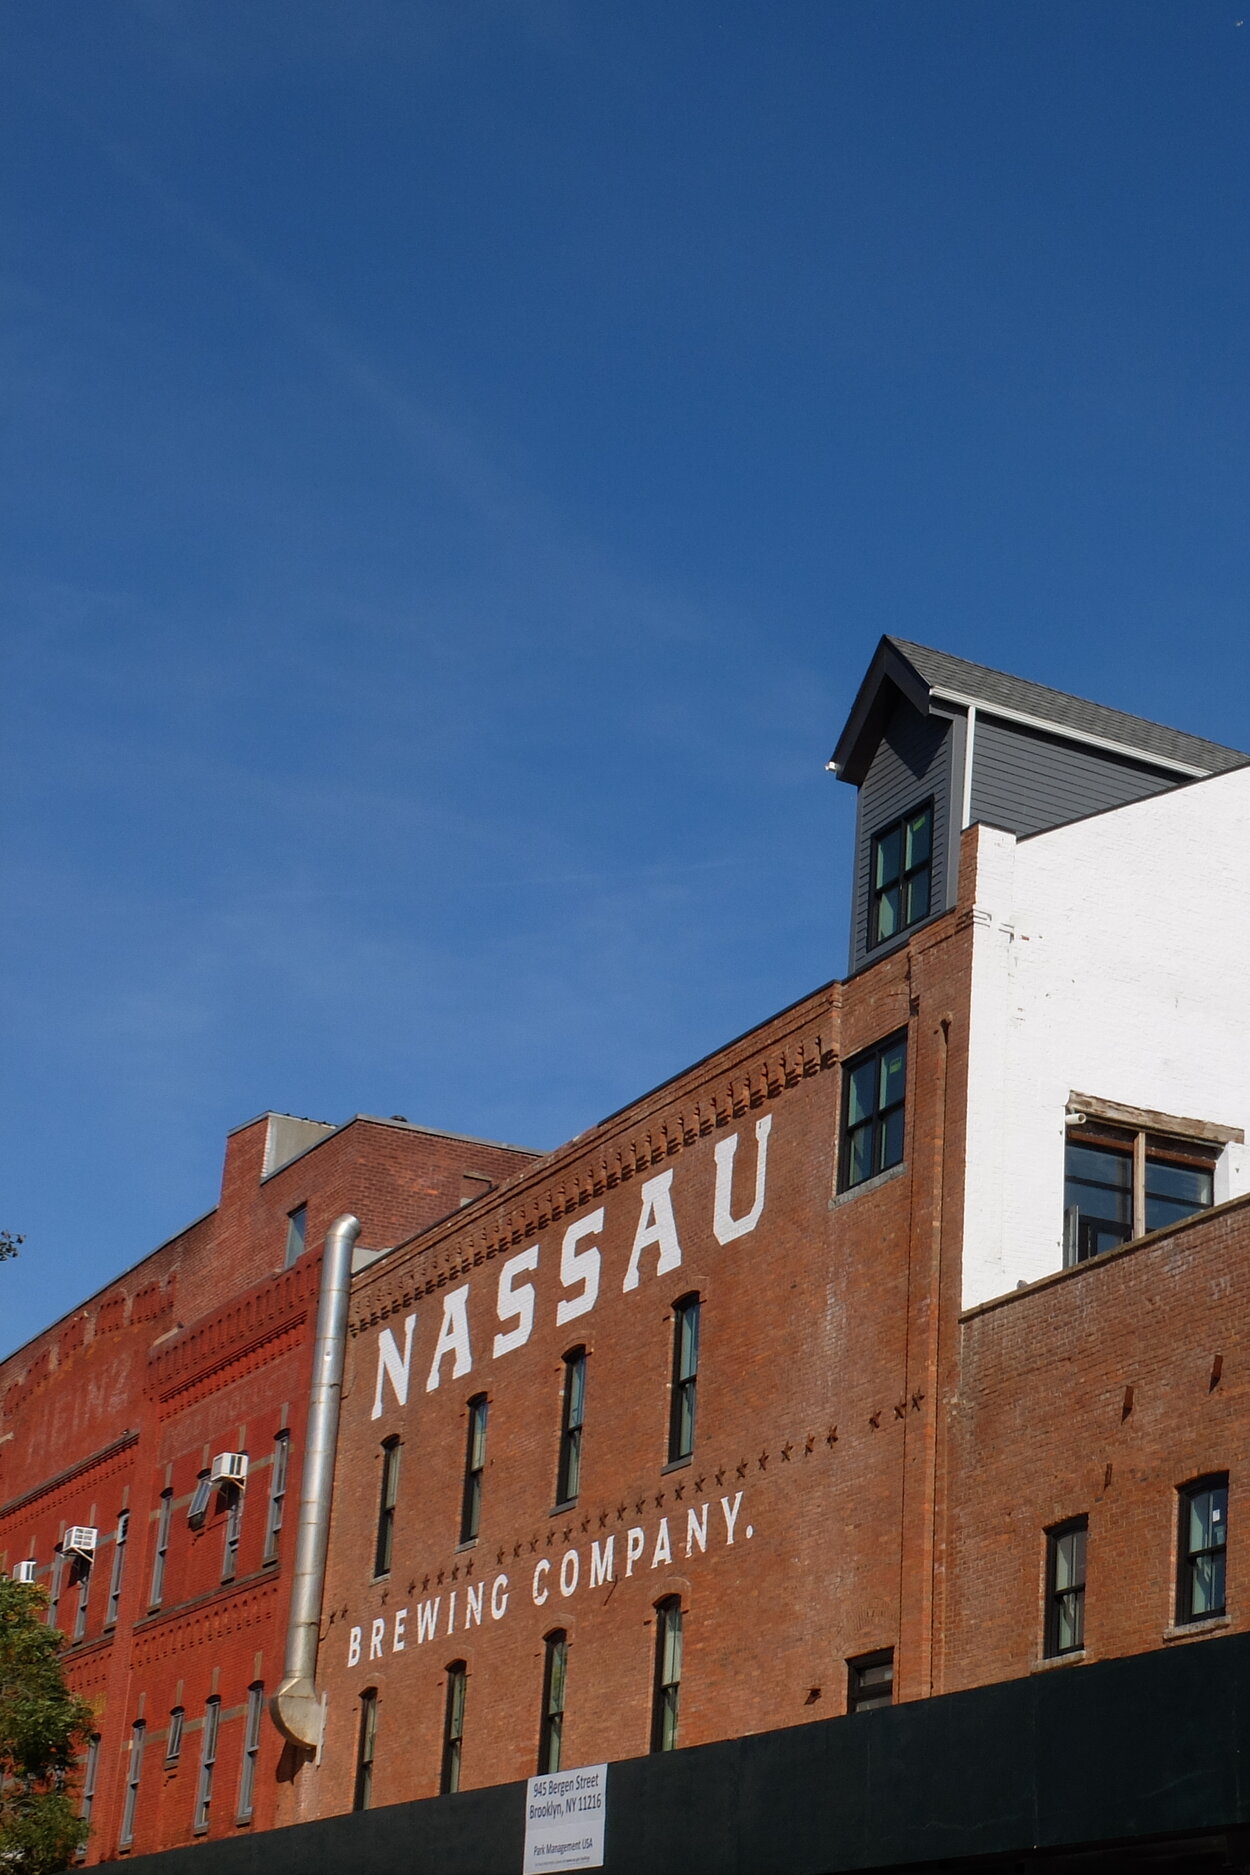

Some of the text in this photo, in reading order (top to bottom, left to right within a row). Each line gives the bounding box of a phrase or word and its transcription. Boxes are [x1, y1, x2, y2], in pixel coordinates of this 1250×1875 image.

[371, 1114, 773, 1421] NASSAU
[347, 1491, 754, 1668] BREWING COMPANY.
[533, 1773, 599, 1798] 945 Bergen Street
[529, 1793, 601, 1819] Brooklyn, NY 11216
[533, 1838, 593, 1856] Park Management USA
